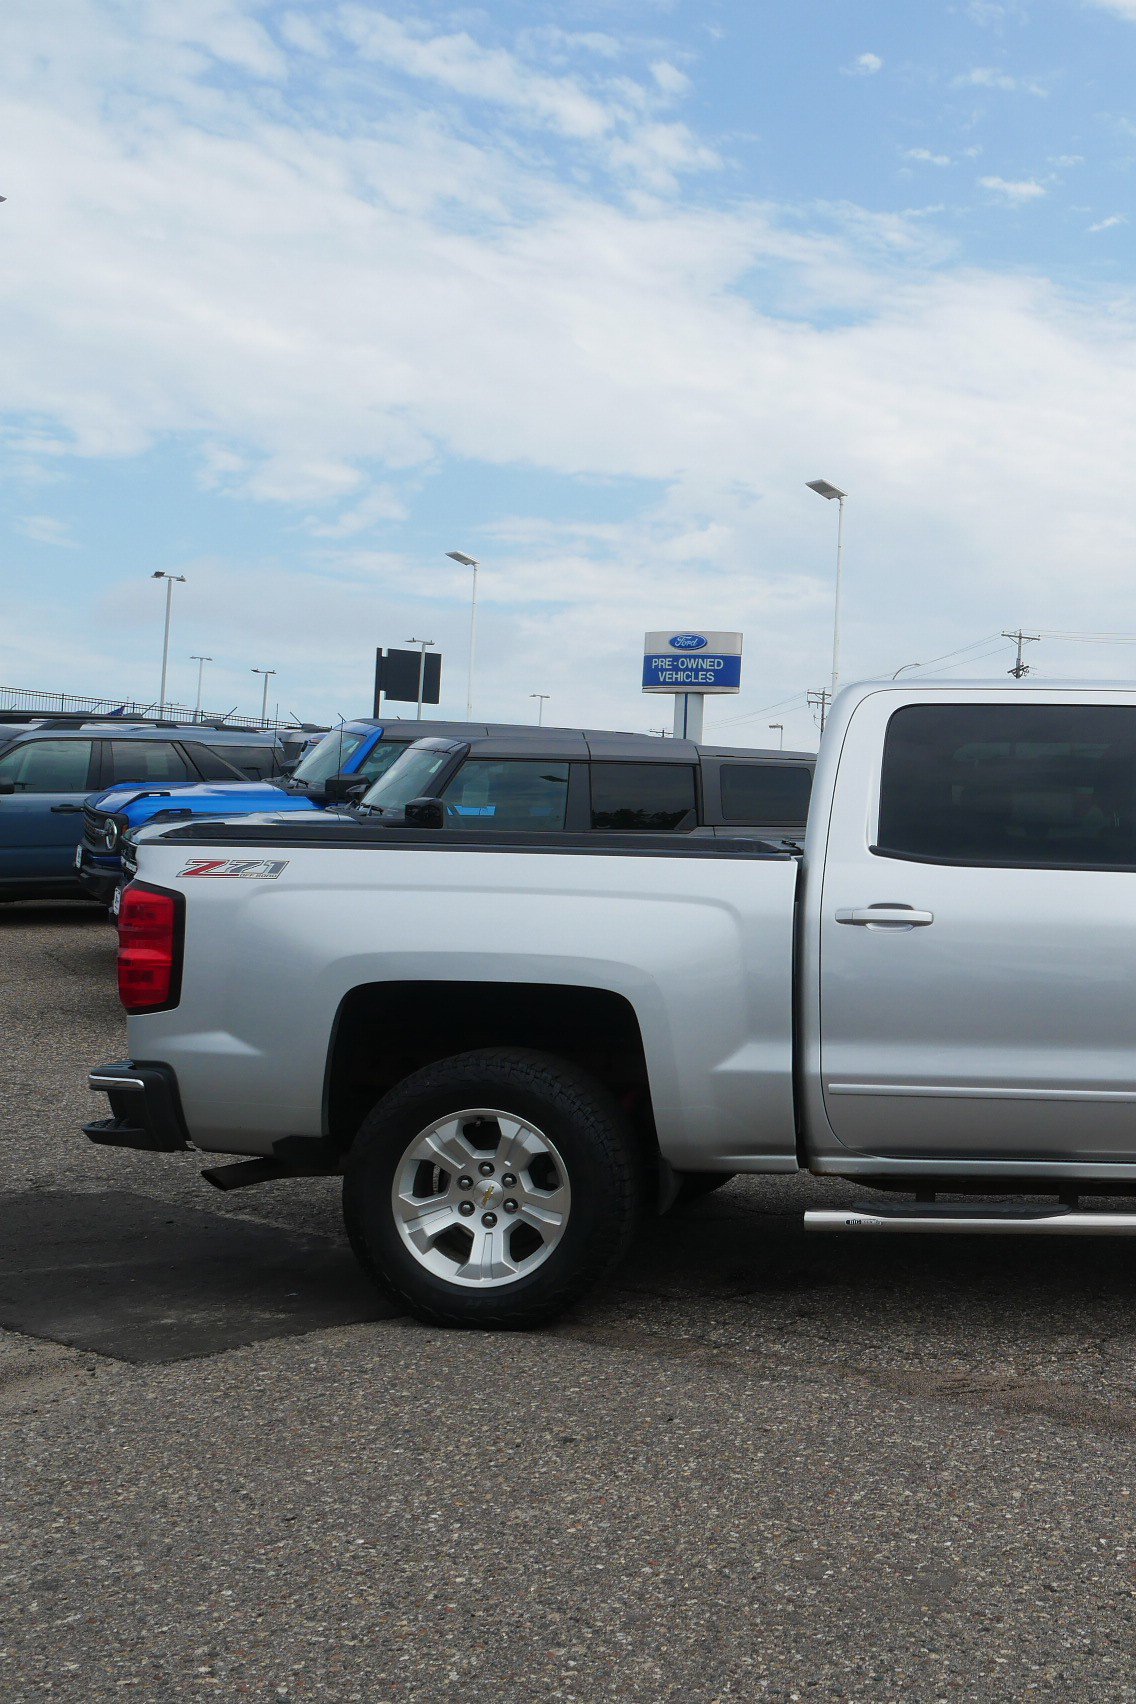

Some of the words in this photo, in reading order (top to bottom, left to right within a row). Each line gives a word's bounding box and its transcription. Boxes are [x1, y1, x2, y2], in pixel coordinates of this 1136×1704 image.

[674, 635, 698, 646] Ford
[651, 658, 724, 669] PRE-OWNED
[658, 671, 715, 682] VEHICLES
[177, 859, 289, 879] Z71
